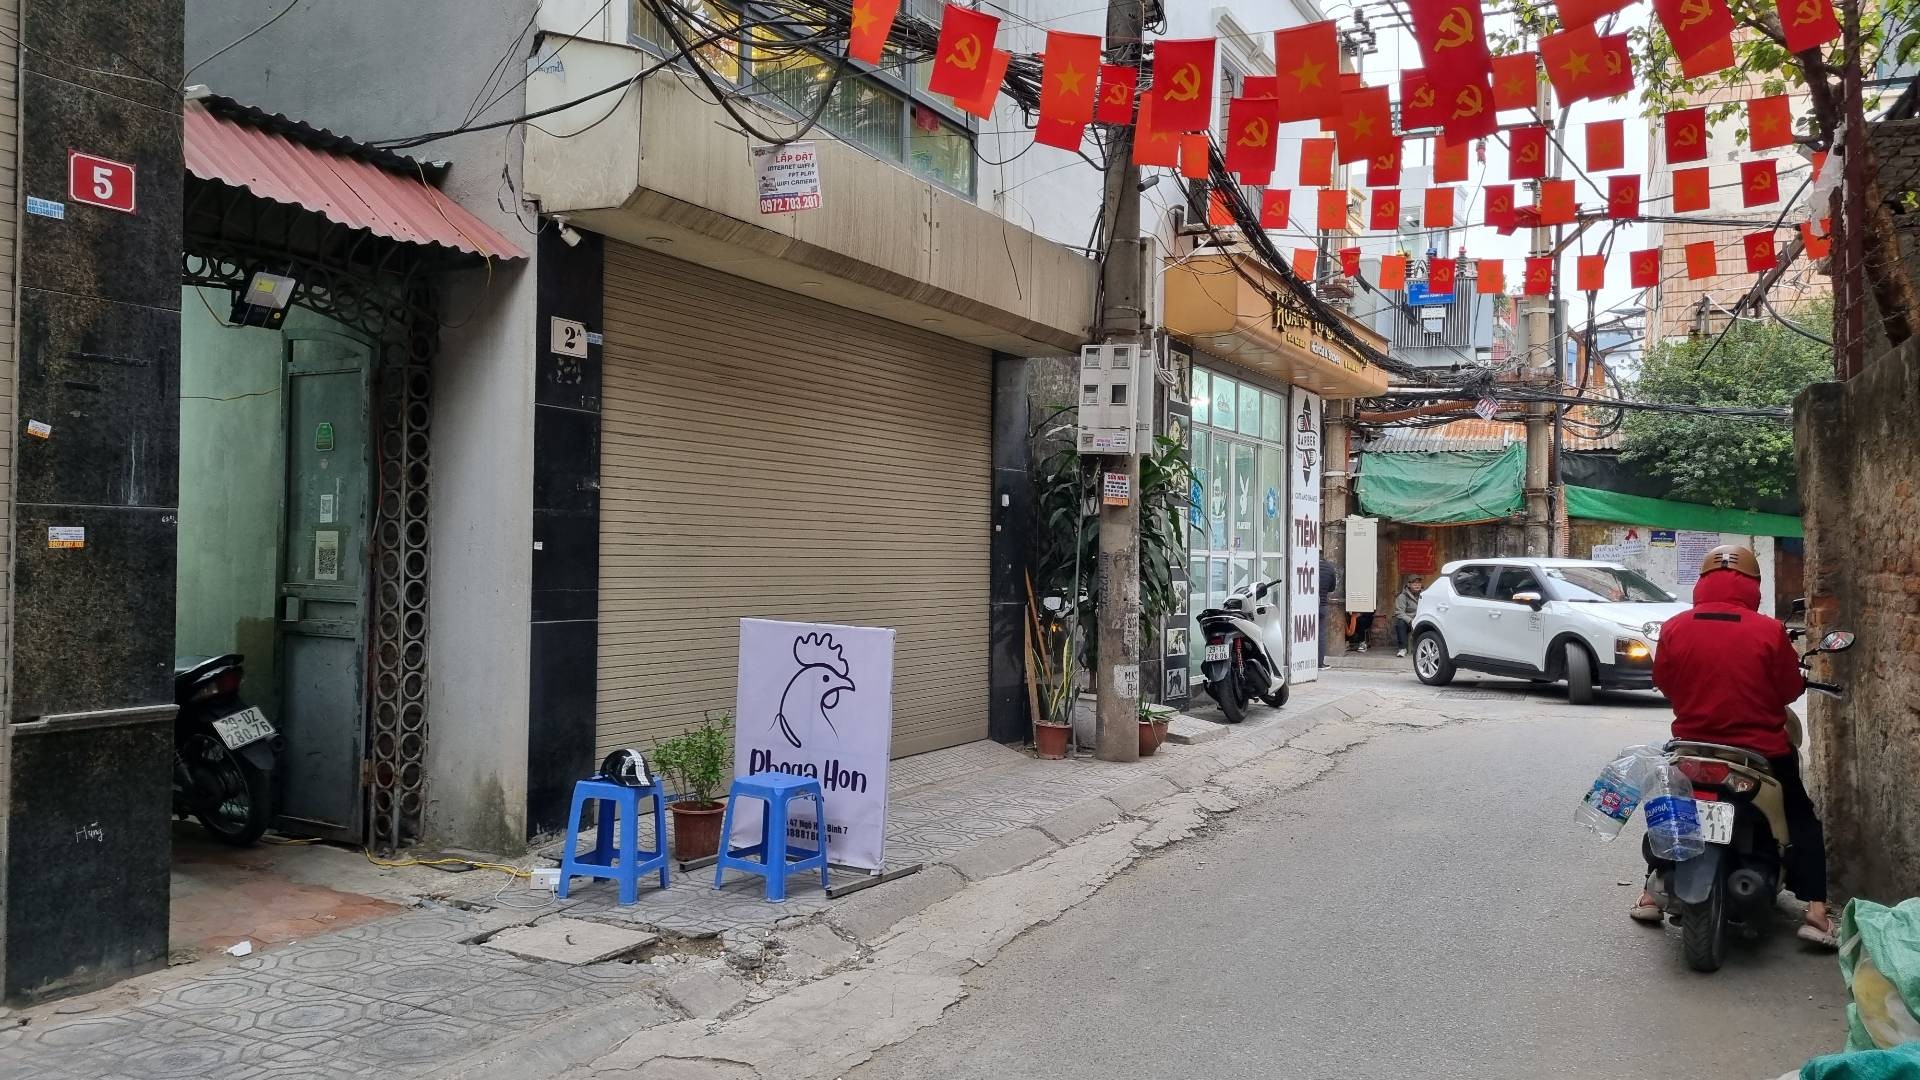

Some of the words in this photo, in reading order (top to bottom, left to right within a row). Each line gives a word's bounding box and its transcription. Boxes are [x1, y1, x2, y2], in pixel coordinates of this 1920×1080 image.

[767, 164, 796, 172] INTERNET
[775, 151, 793, 163] LẮP
[795, 151, 814, 163] ĐẶT
[93, 166, 113, 199] 5
[1294, 513, 1318, 555] TIỆM
[1296, 560, 1315, 595] TÓC
[1294, 614, 1316, 643] NAM
[823, 759, 867, 793] Hon
[843, 826, 848, 835] 7
